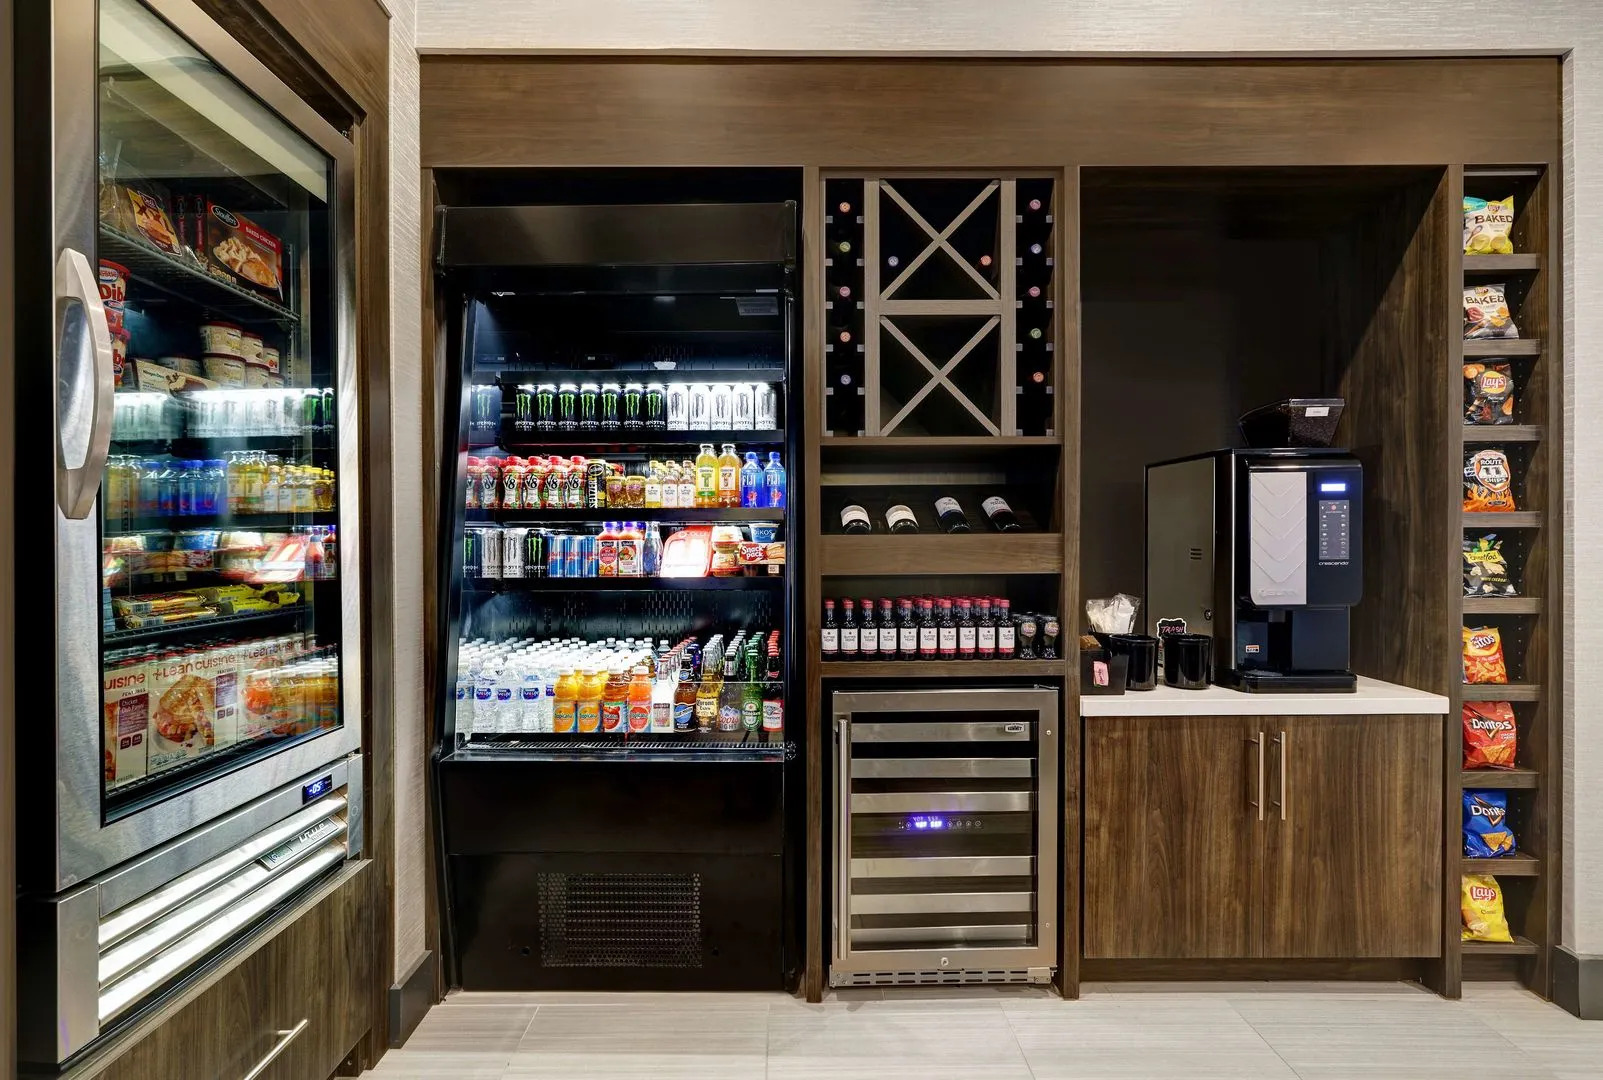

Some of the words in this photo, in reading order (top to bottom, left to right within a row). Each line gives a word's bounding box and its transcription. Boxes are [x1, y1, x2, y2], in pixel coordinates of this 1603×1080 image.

[1474, 214, 1513, 224] BAKED
[1465, 295, 1505, 304] BAKED
[1482, 466, 1501, 475] 11
[503, 473, 516, 489] V8
[526, 473, 539, 489] V8
[546, 473, 558, 489] V8
[567, 473, 579, 489] V8
[742, 474, 756, 487] FIJI
[741, 545, 763, 555] Snack
[1161, 626, 1184, 634] TRASH
[162, 663, 194, 678] Lean
[195, 653, 236, 671] cuisine
[1472, 718, 1513, 730] Doritos
